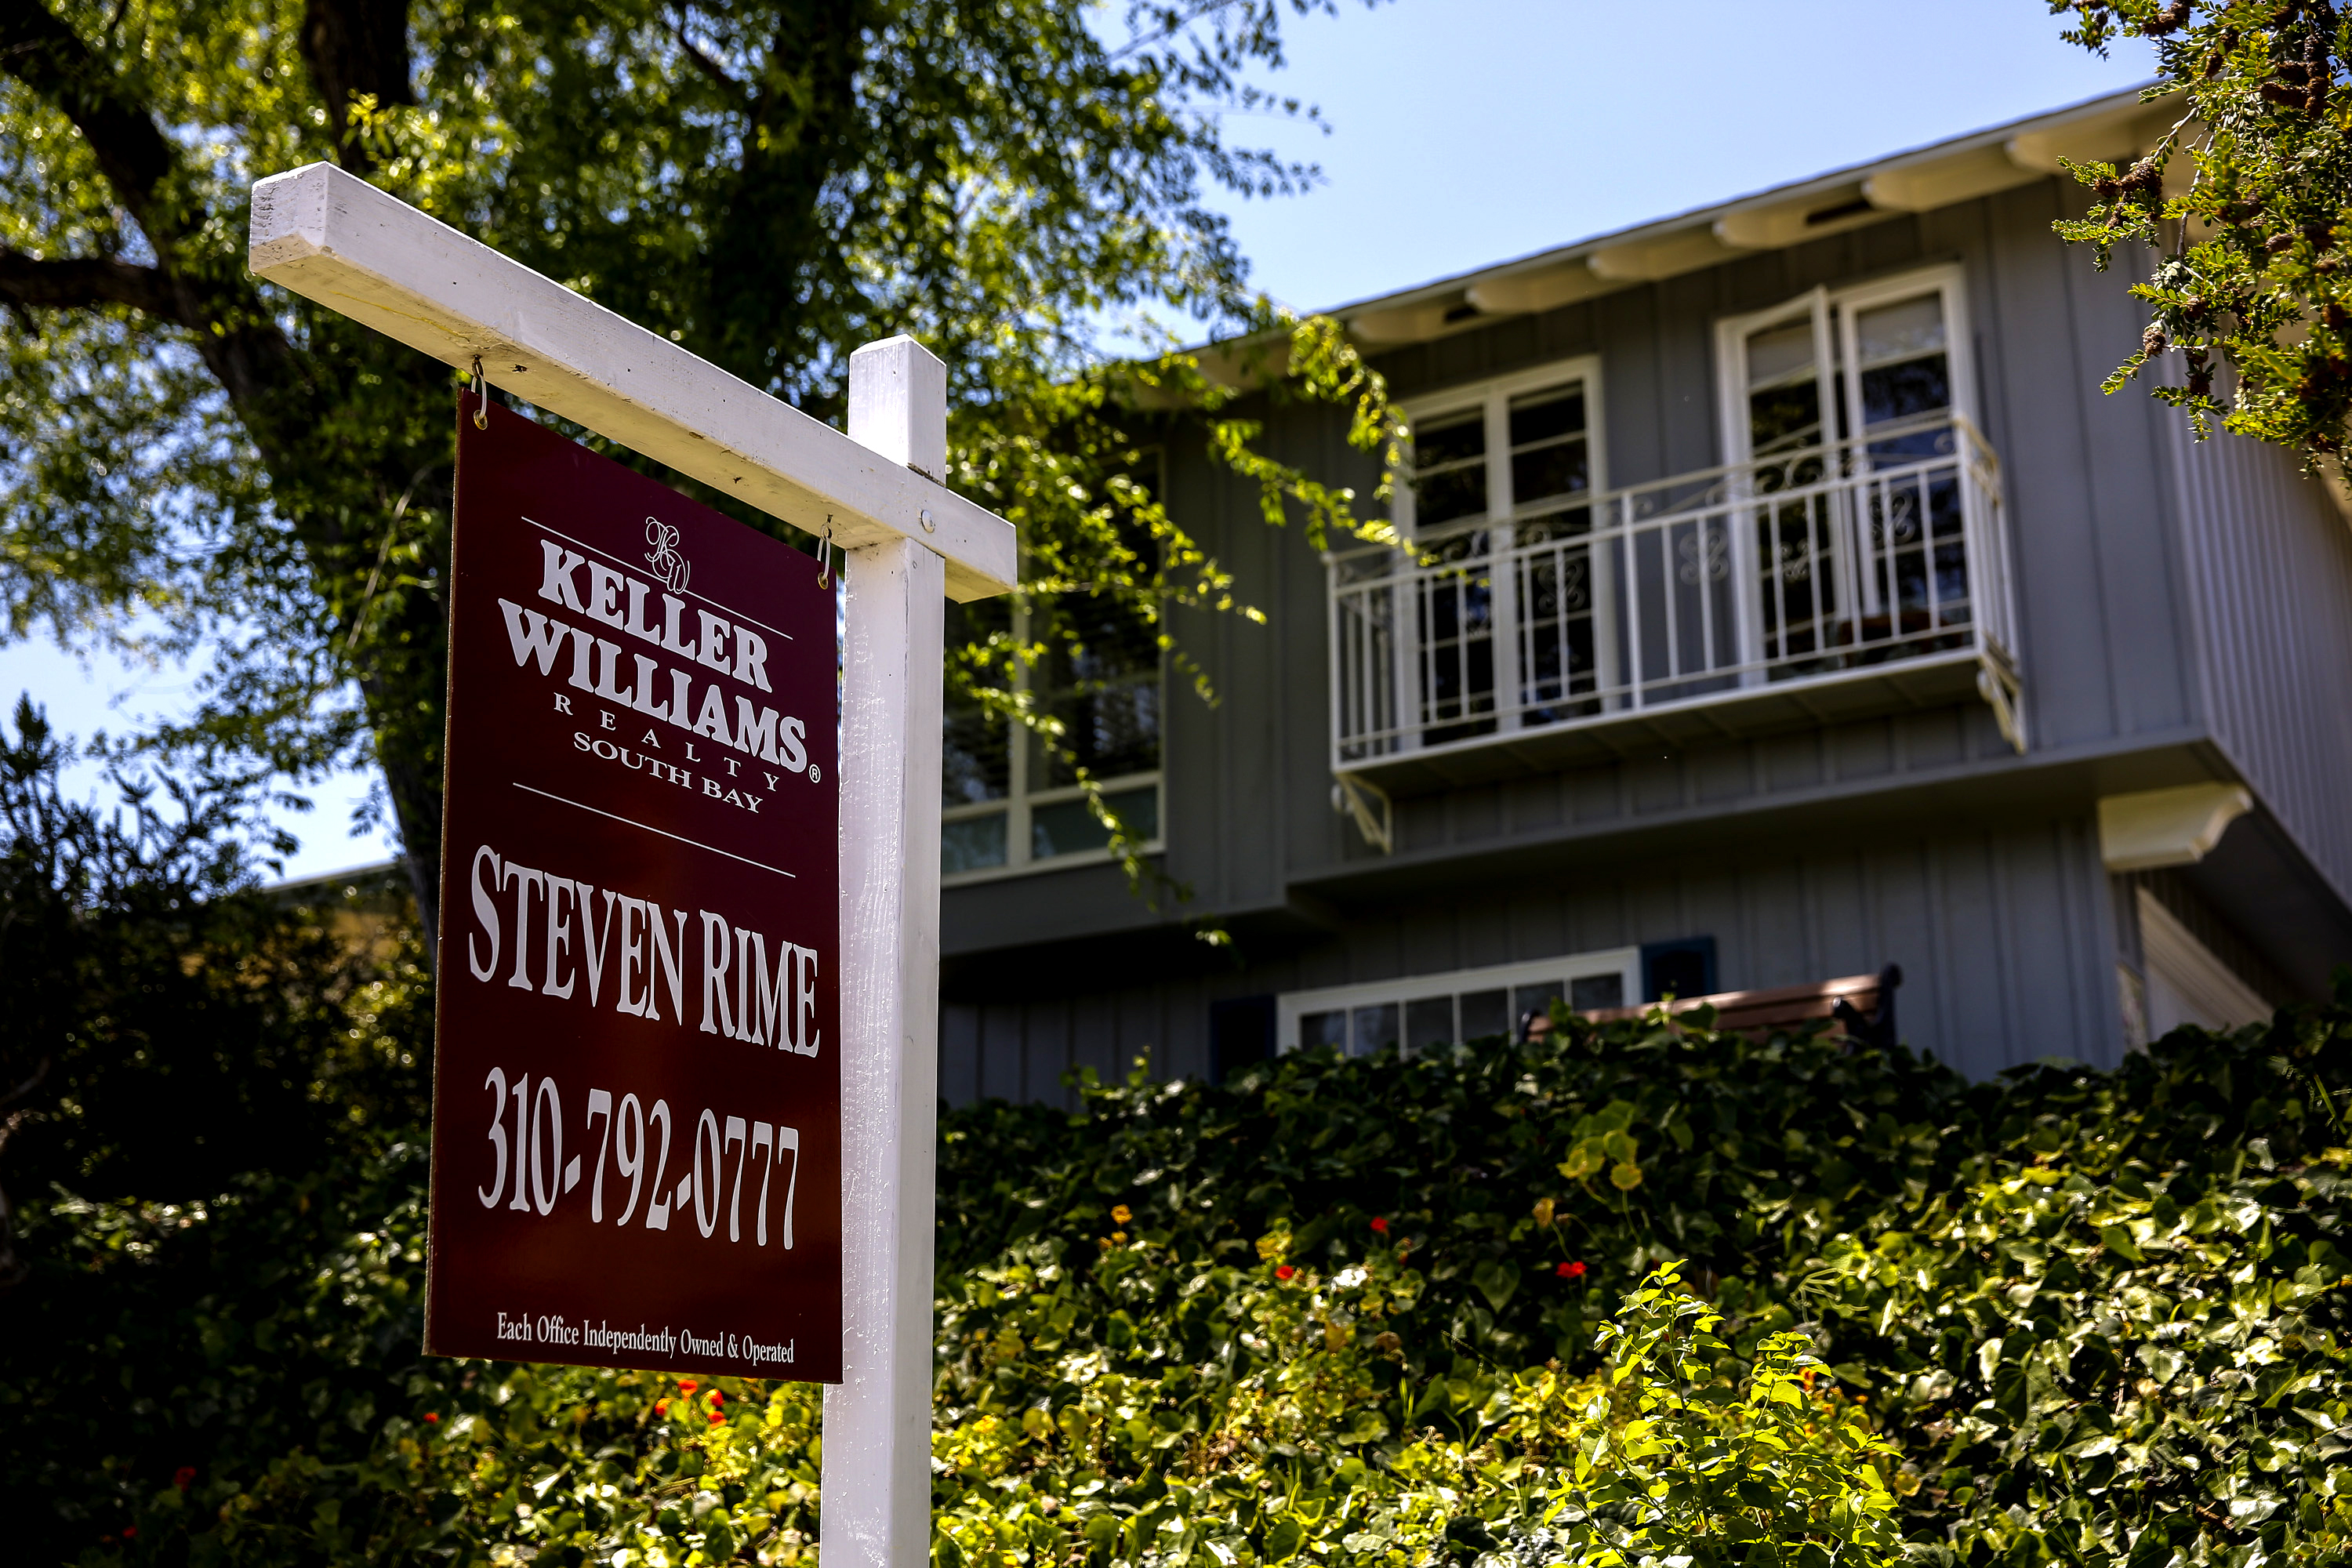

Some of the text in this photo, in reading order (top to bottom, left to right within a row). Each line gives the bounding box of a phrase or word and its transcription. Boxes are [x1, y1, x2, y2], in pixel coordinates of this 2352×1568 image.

[538, 539, 773, 694] KELLER
[553, 691, 781, 793] REALTY
[573, 731, 764, 814] SOUTH BAY
[469, 844, 820, 1058] STEVEN RIME
[478, 1066, 799, 1250] 310-792-0777
[497, 1312, 795, 1367] Each Office Independently Owned & Operated
